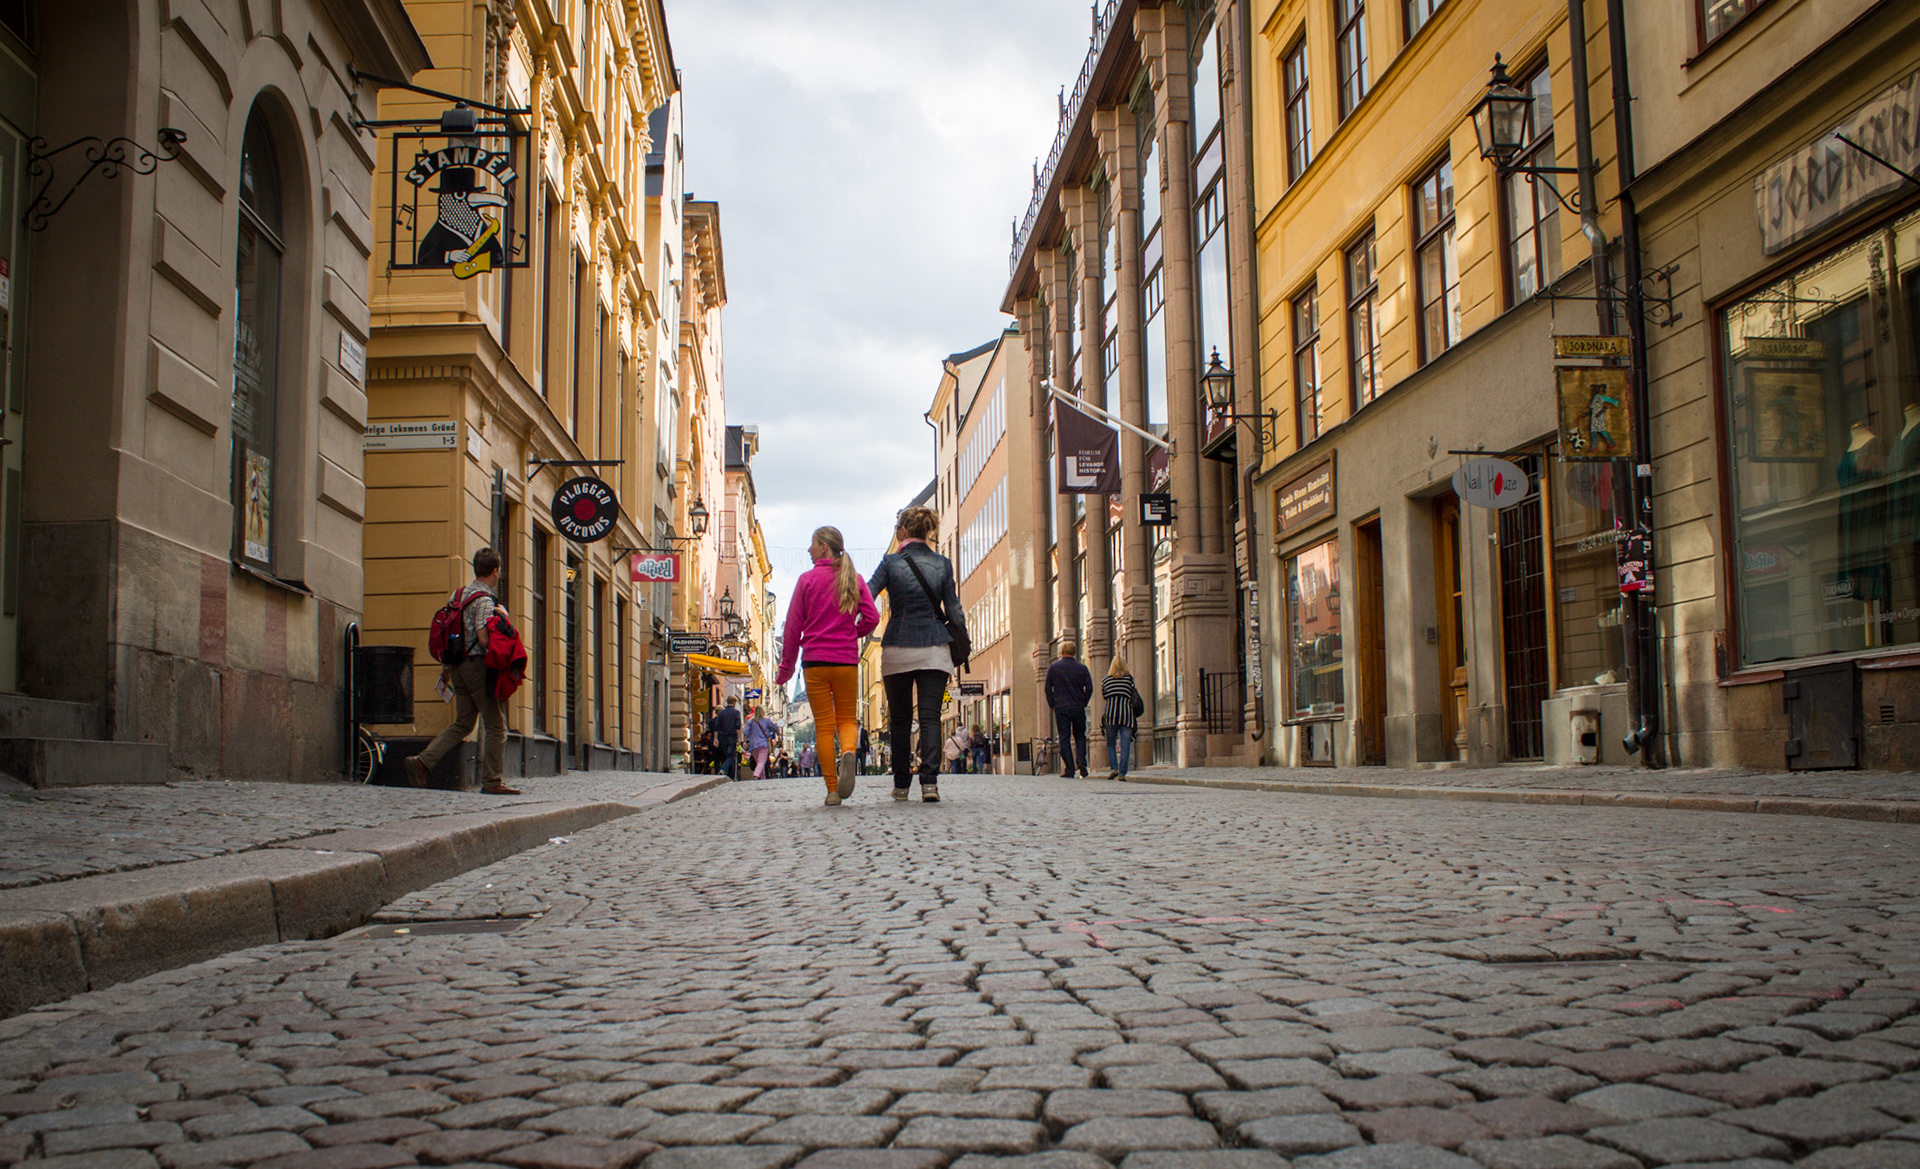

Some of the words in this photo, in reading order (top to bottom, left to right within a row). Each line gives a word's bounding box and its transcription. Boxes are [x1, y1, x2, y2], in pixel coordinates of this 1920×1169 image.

[409, 147, 516, 185] STAMPEN
[390, 423, 427, 433] Lekamens
[432, 422, 456, 431] Gränd
[442, 436, 455, 445] 1-5
[560, 482, 612, 505] PLUGGED
[560, 515, 610, 537] RECORDS
